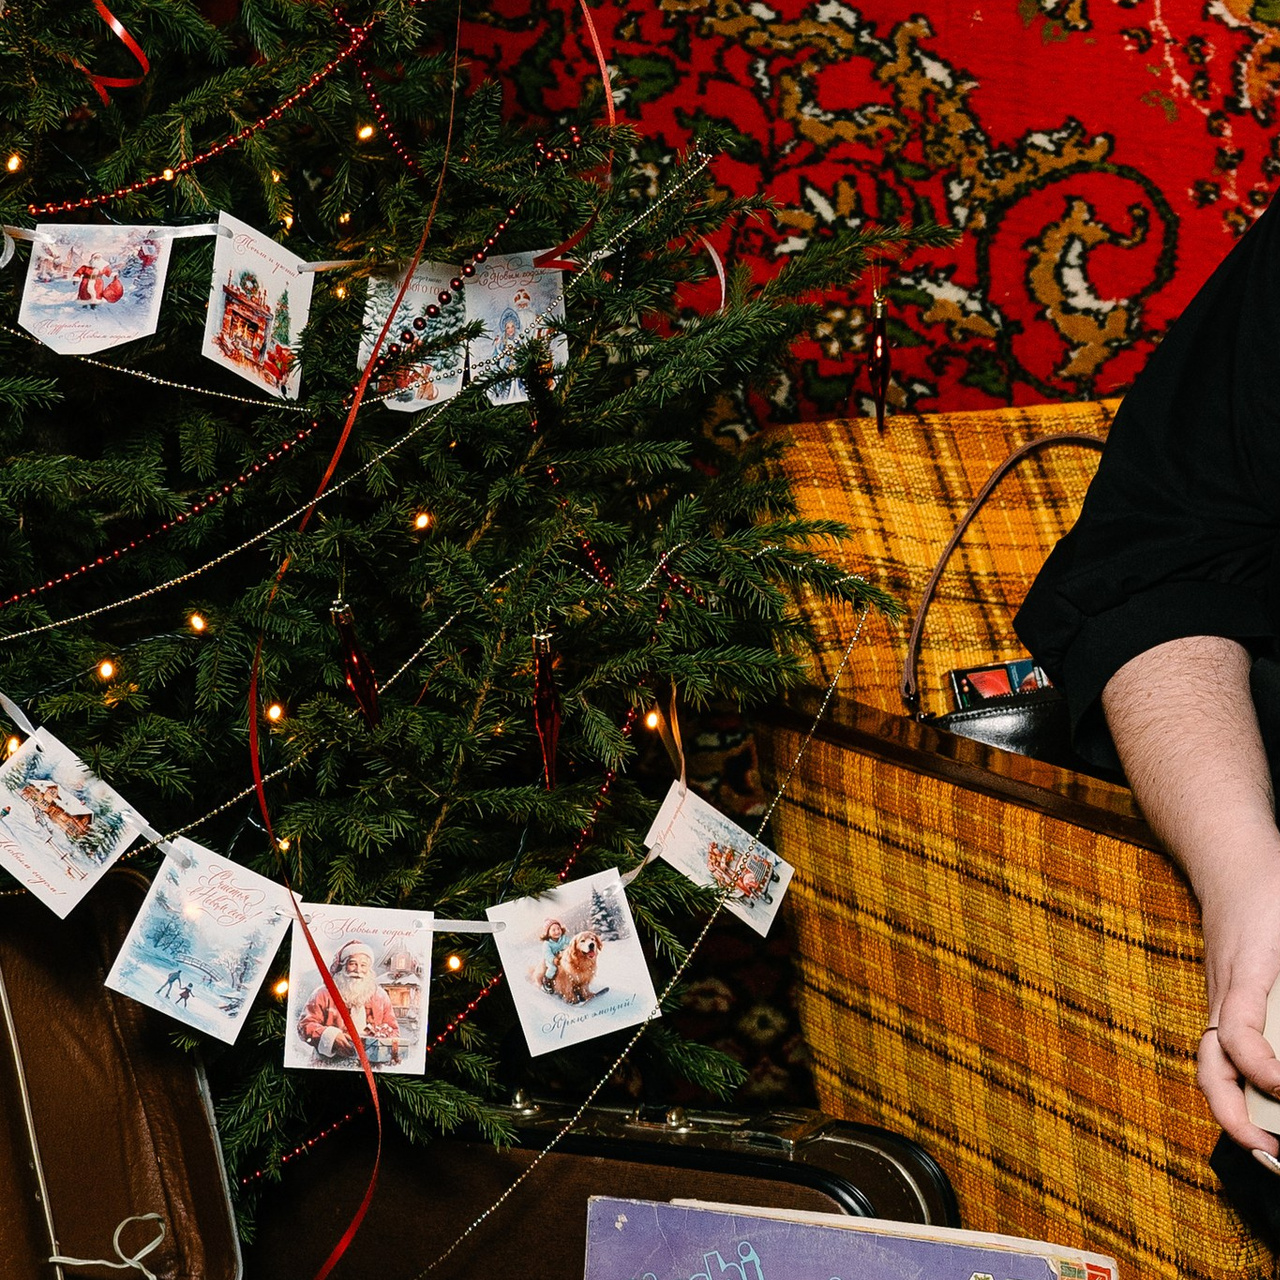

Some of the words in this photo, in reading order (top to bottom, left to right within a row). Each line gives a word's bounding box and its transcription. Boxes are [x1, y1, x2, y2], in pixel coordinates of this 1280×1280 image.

[27, 871, 67, 895] годом!
[322, 916, 378, 940] Новым
[382, 929, 418, 946] годом!
[541, 1013, 589, 1039] Ярких
[592, 993, 636, 1018] эмоций!
